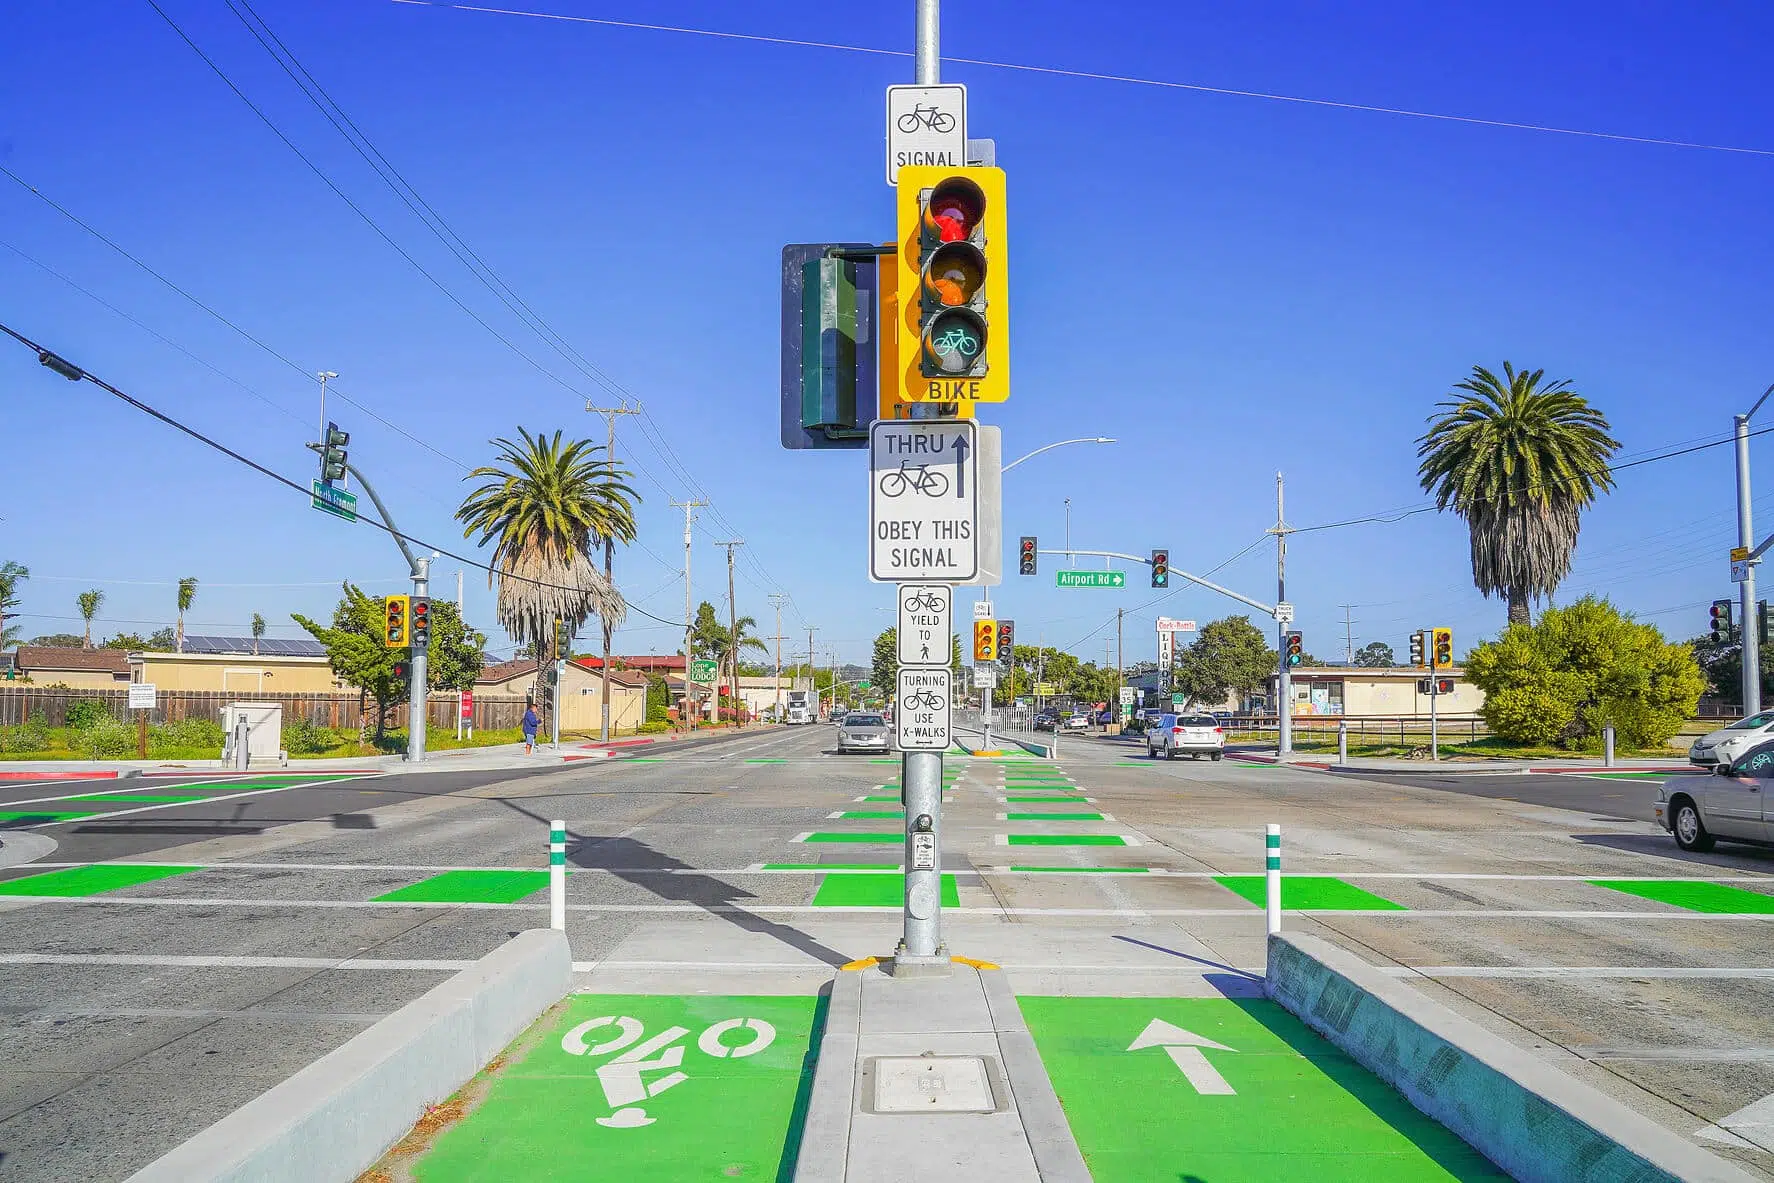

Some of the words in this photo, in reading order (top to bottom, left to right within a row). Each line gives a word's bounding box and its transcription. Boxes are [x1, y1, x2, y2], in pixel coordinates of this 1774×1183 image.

[897, 152, 956, 167] SIGNAL
[929, 382, 980, 399] BIKE
[885, 435, 943, 453] THRU
[878, 521, 922, 539] OBEY
[932, 521, 970, 539] THIS
[891, 549, 957, 567] SIGNAL
[1061, 573, 1094, 587] Airport
[1098, 574, 1109, 584] Rd
[910, 615, 939, 626] YIELD
[919, 630, 930, 640] TO
[904, 676, 945, 686] TURNING
[914, 714, 934, 724] USE
[904, 728, 946, 738] X-WALKS
